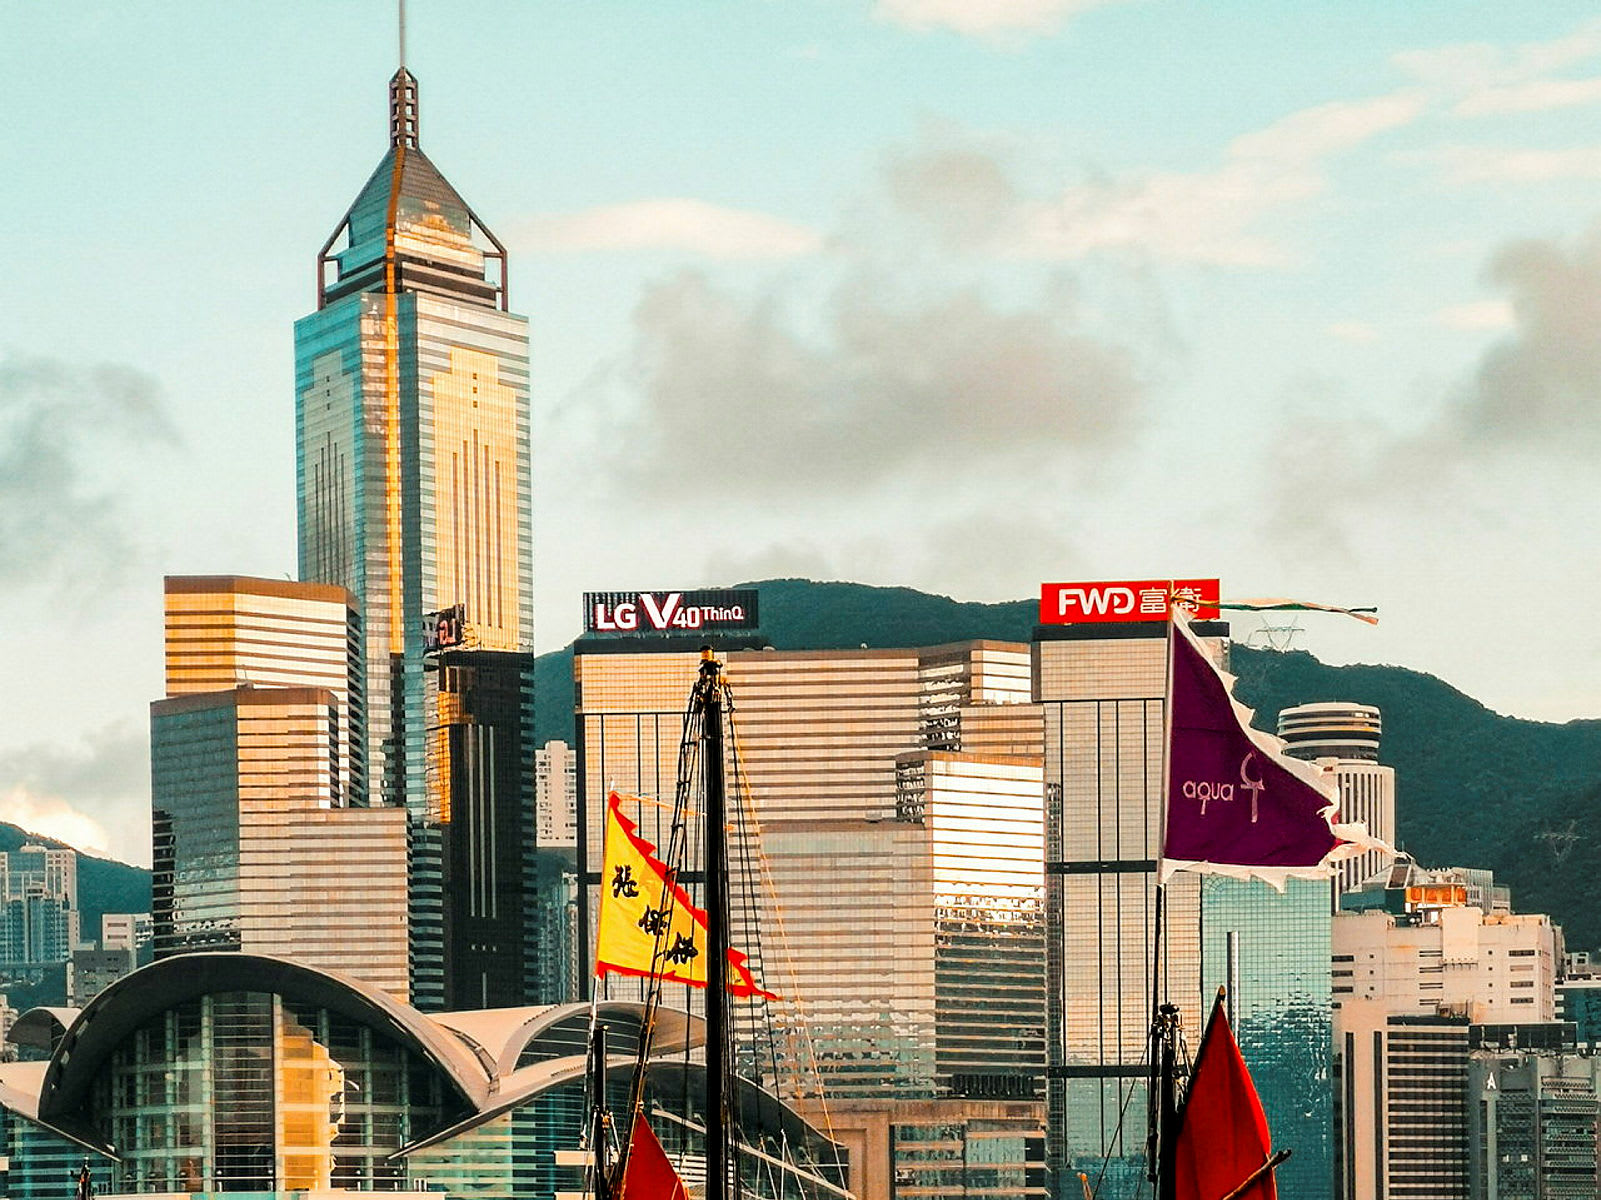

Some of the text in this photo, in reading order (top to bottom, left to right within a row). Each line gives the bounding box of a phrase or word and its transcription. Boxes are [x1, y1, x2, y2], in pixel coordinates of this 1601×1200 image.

[1058, 587, 1135, 616] FWD
[595, 603, 638, 630] LG
[700, 605, 745, 621] ThinQ
[1182, 780, 1234, 816] aqua
